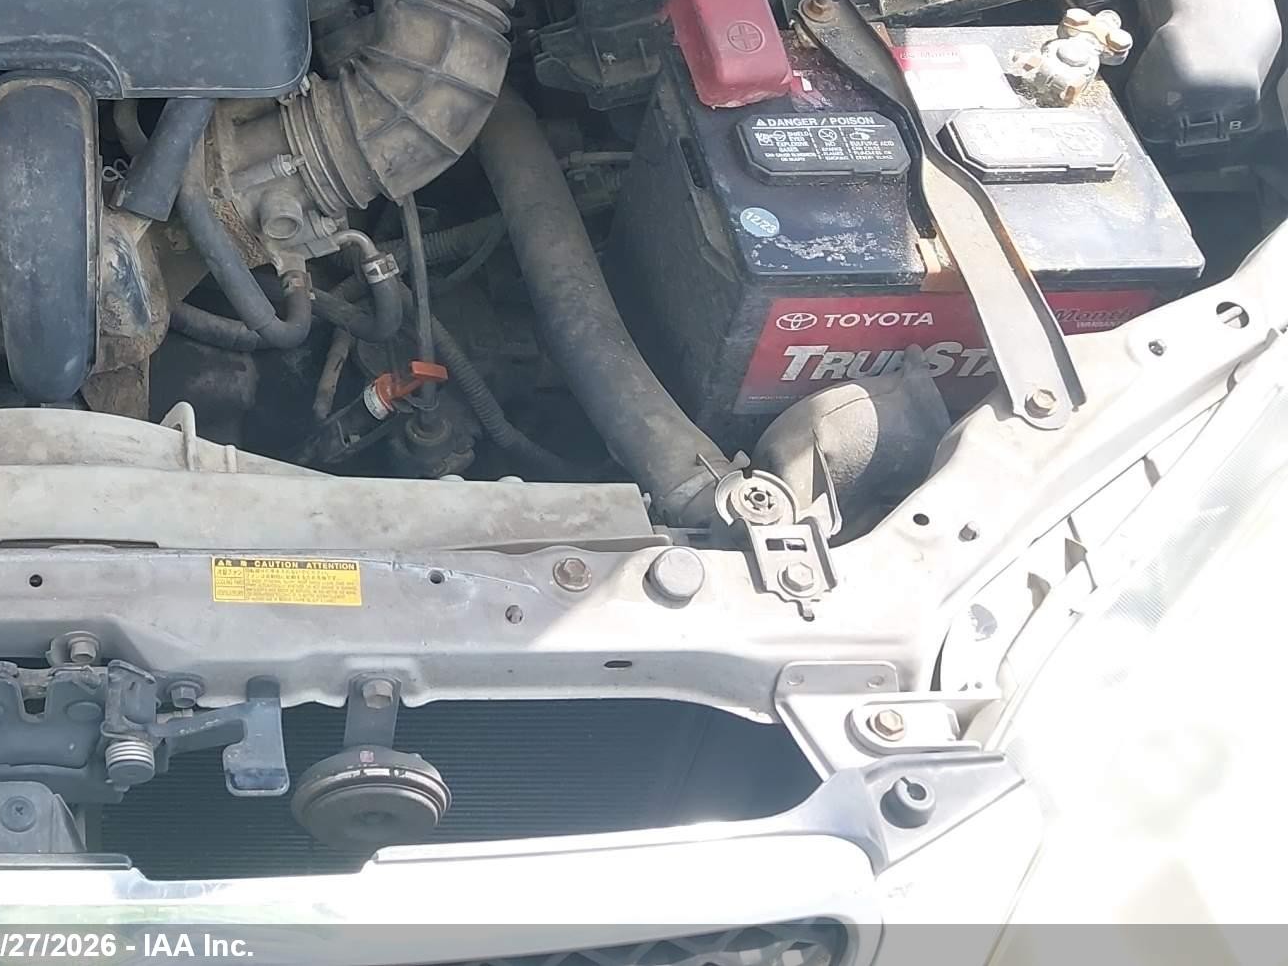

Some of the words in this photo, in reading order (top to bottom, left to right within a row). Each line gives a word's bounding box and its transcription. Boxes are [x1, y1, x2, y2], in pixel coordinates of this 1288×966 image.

[767, 117, 818, 126] DANGER
[820, 117, 828, 125] /
[830, 116, 875, 125] POISON
[745, 211, 778, 234] 12/23
[824, 312, 934, 328] TOYOTA
[254, 561, 299, 569] CAUTION
[306, 562, 355, 570] ATTENTION
